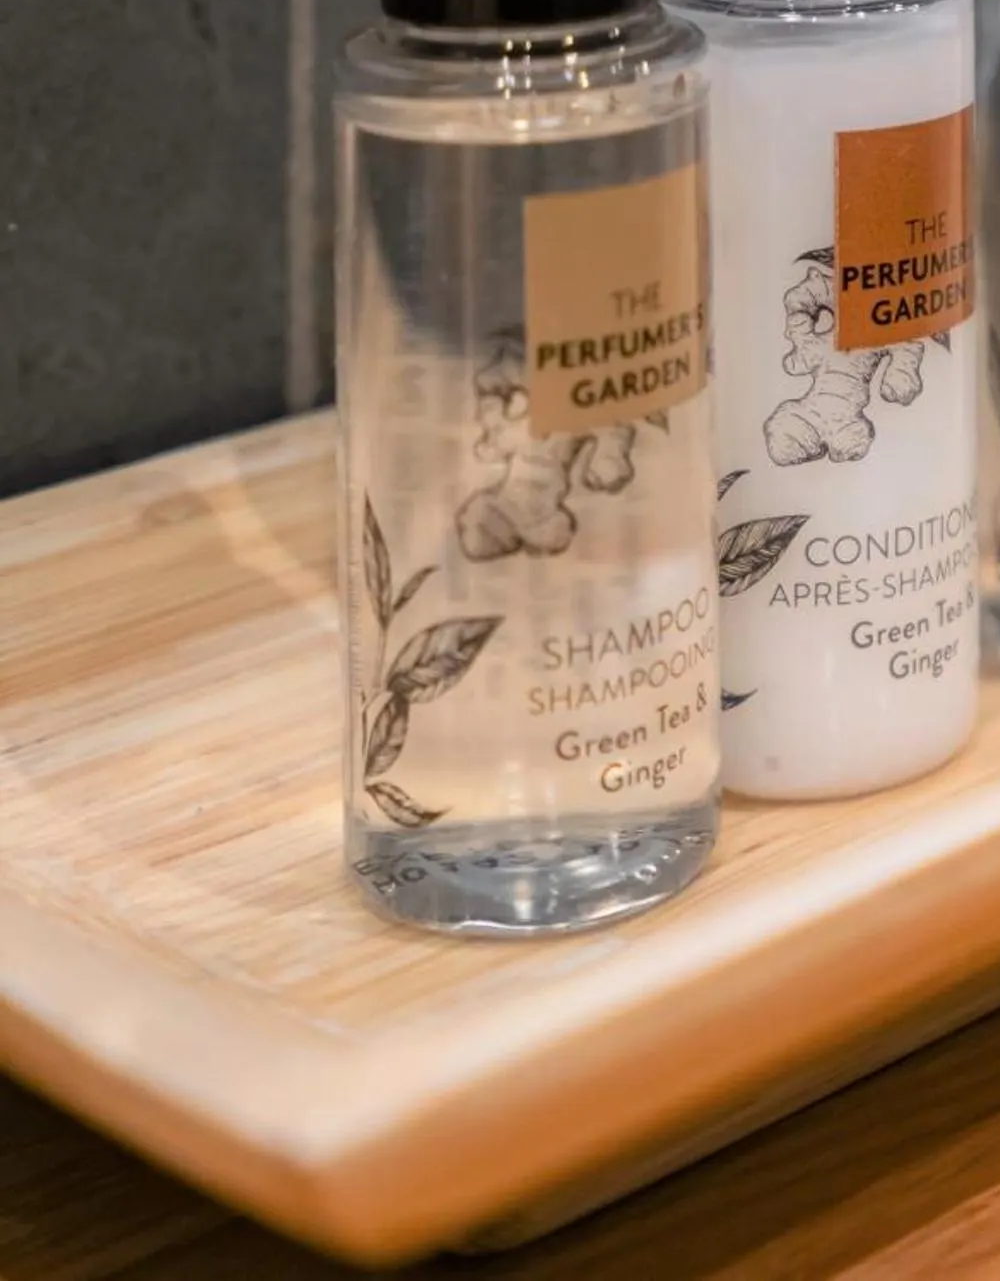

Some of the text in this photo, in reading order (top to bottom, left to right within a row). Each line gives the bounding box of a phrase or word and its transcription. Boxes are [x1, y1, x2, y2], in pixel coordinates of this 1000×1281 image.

[905, 211, 949, 245] THE
[609, 280, 664, 317] THE
[871, 278, 967, 327] GARDEN
[570, 351, 692, 410] GARDEN
[804, 497, 977, 568] CONDITION
[541, 586, 711, 672] SHAMPOO
[850, 617, 929, 650] Green
[935, 598, 963, 628] Tea
[888, 638, 960, 680] Ginger
[554, 682, 708, 762] Green Tea &
[599, 746, 687, 794] Ginger
